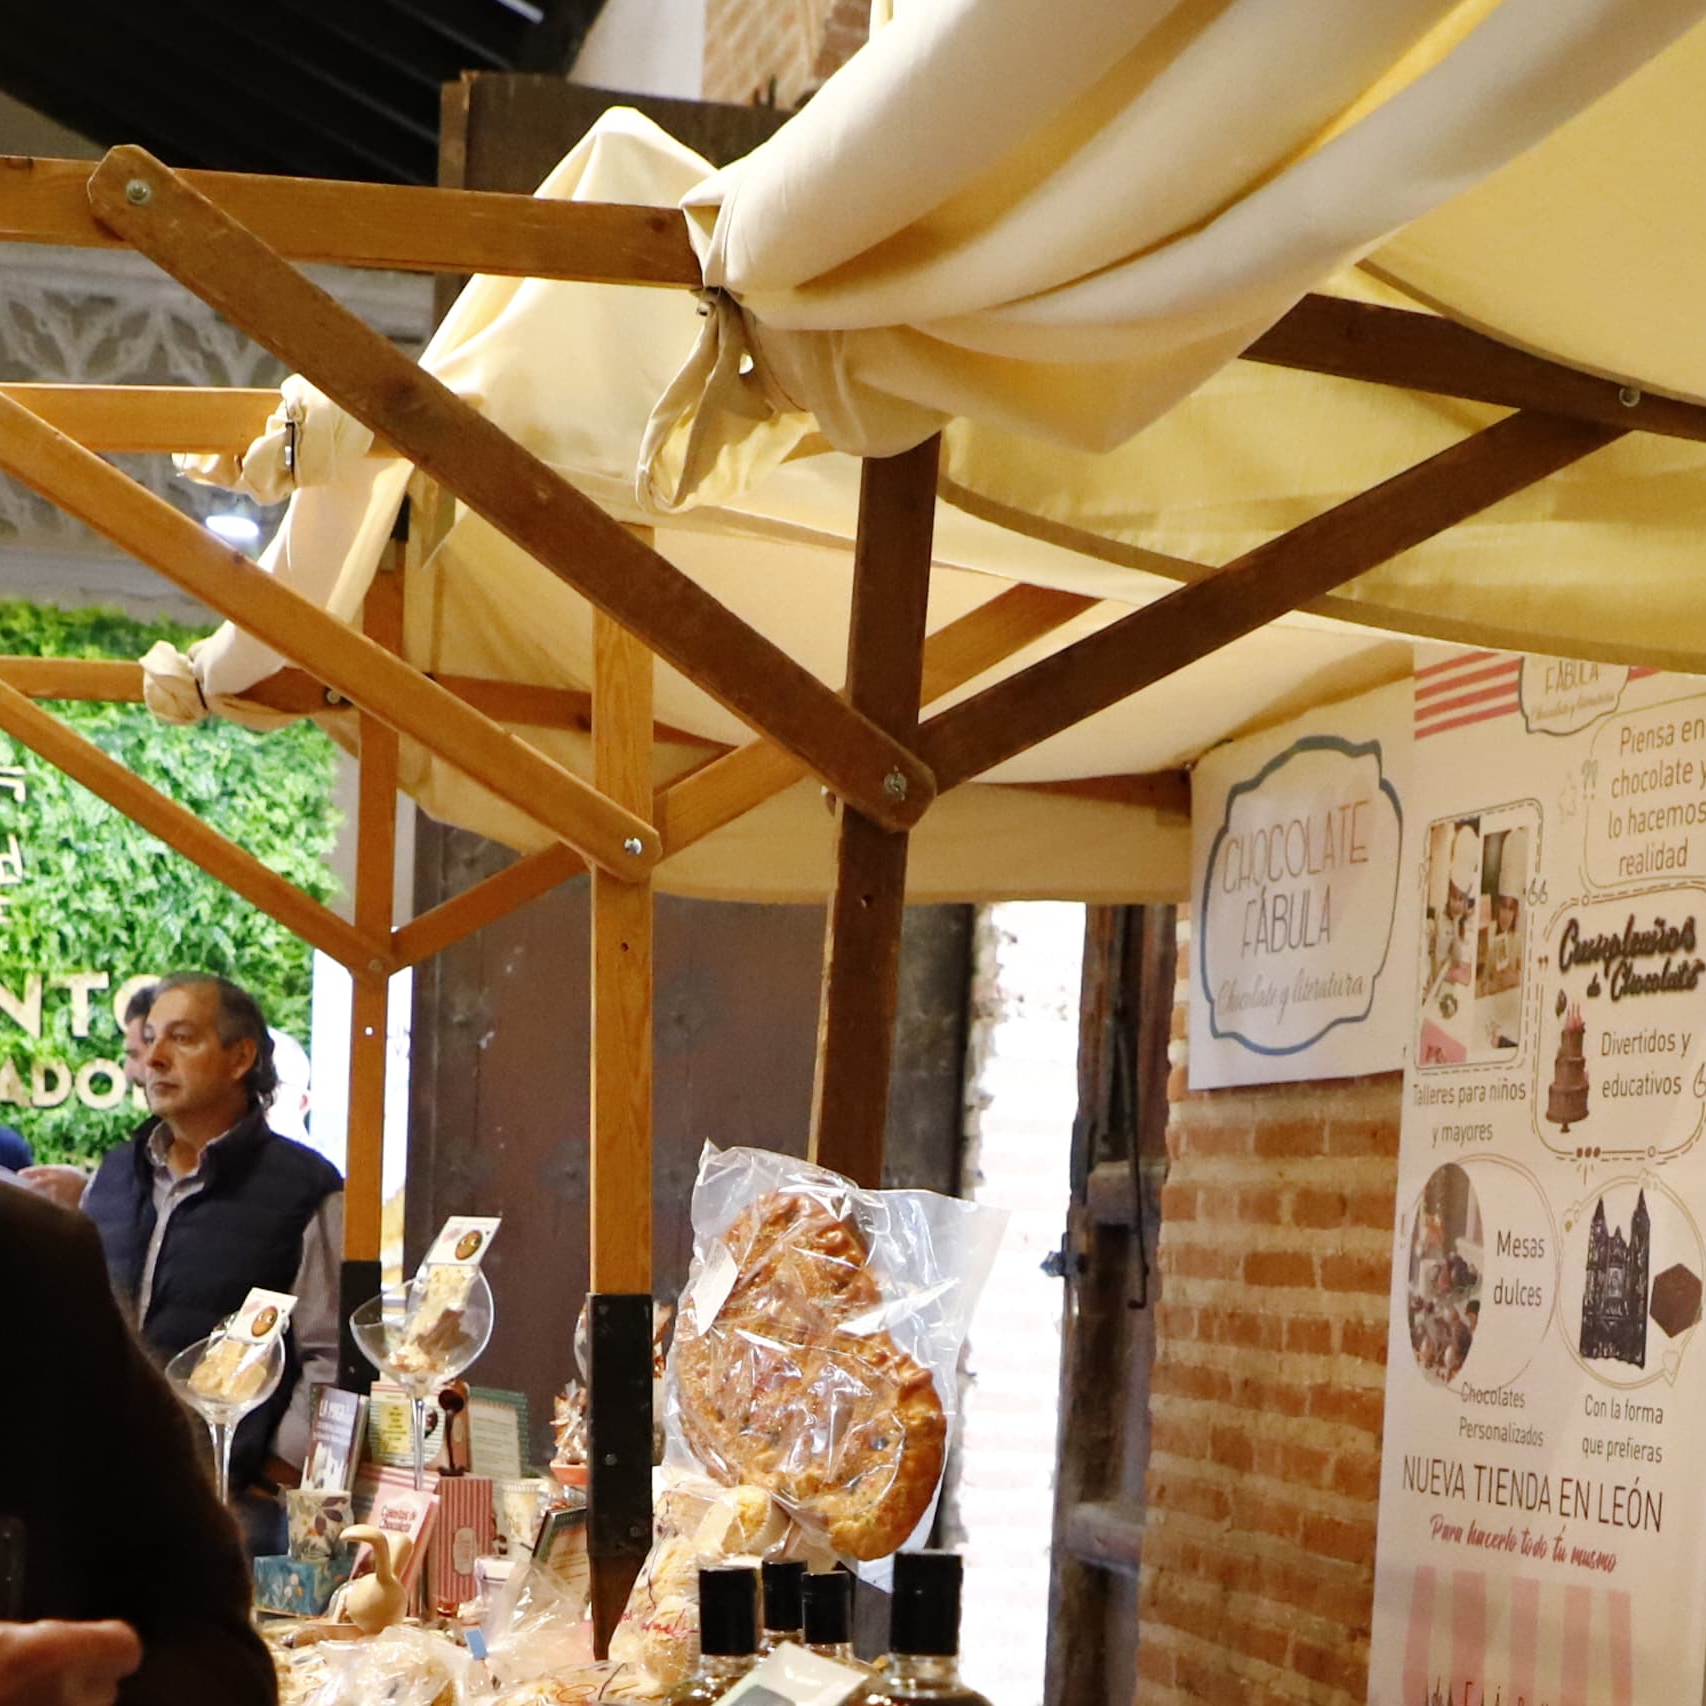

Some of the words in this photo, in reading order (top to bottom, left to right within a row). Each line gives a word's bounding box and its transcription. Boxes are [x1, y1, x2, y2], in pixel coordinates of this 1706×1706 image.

[1621, 723, 1674, 755] Piensa
[1681, 718, 1705, 742] en
[1611, 759, 1693, 799] chocolate
[1608, 810, 1622, 839] lo
[1222, 800, 1369, 893] CHOCOLATE
[1619, 838, 1688, 877] realidad
[1242, 884, 1330, 958] FÁBULA
[1559, 913, 1695, 979] Cumpleaños
[1611, 958, 1706, 1002] Chocolate
[1601, 1028, 1675, 1056] Divertidos
[1681, 1032, 1691, 1057] y
[1413, 1083, 1454, 1106] Talleres
[1458, 1084, 1486, 1108] para
[1490, 1078, 1525, 1102] niños
[1602, 1072, 1681, 1098] educativos
[1432, 1126, 1438, 1149] y
[1442, 1123, 1493, 1147] mayores
[1497, 1231, 1544, 1258] Mesas
[1493, 1277, 1542, 1307] dulces
[1461, 1382, 1525, 1408] Chocolates
[1585, 1394, 1606, 1417] Con
[1611, 1396, 1621, 1419] la
[1624, 1397, 1663, 1425] forma
[1459, 1417, 1543, 1447] Personalizados
[1582, 1437, 1602, 1457] que
[1607, 1438, 1662, 1463] prefieras
[1403, 1455, 1465, 1499] NUEVA
[1474, 1464, 1551, 1513] TIENDA
[1559, 1478, 1591, 1520] EN
[1598, 1476, 1663, 1533] LEÓN
[1430, 1514, 1462, 1544] Para
[1467, 1520, 1517, 1552] hacerlo
[1520, 1528, 1547, 1558] todo
[1553, 1524, 1567, 1563] tú
